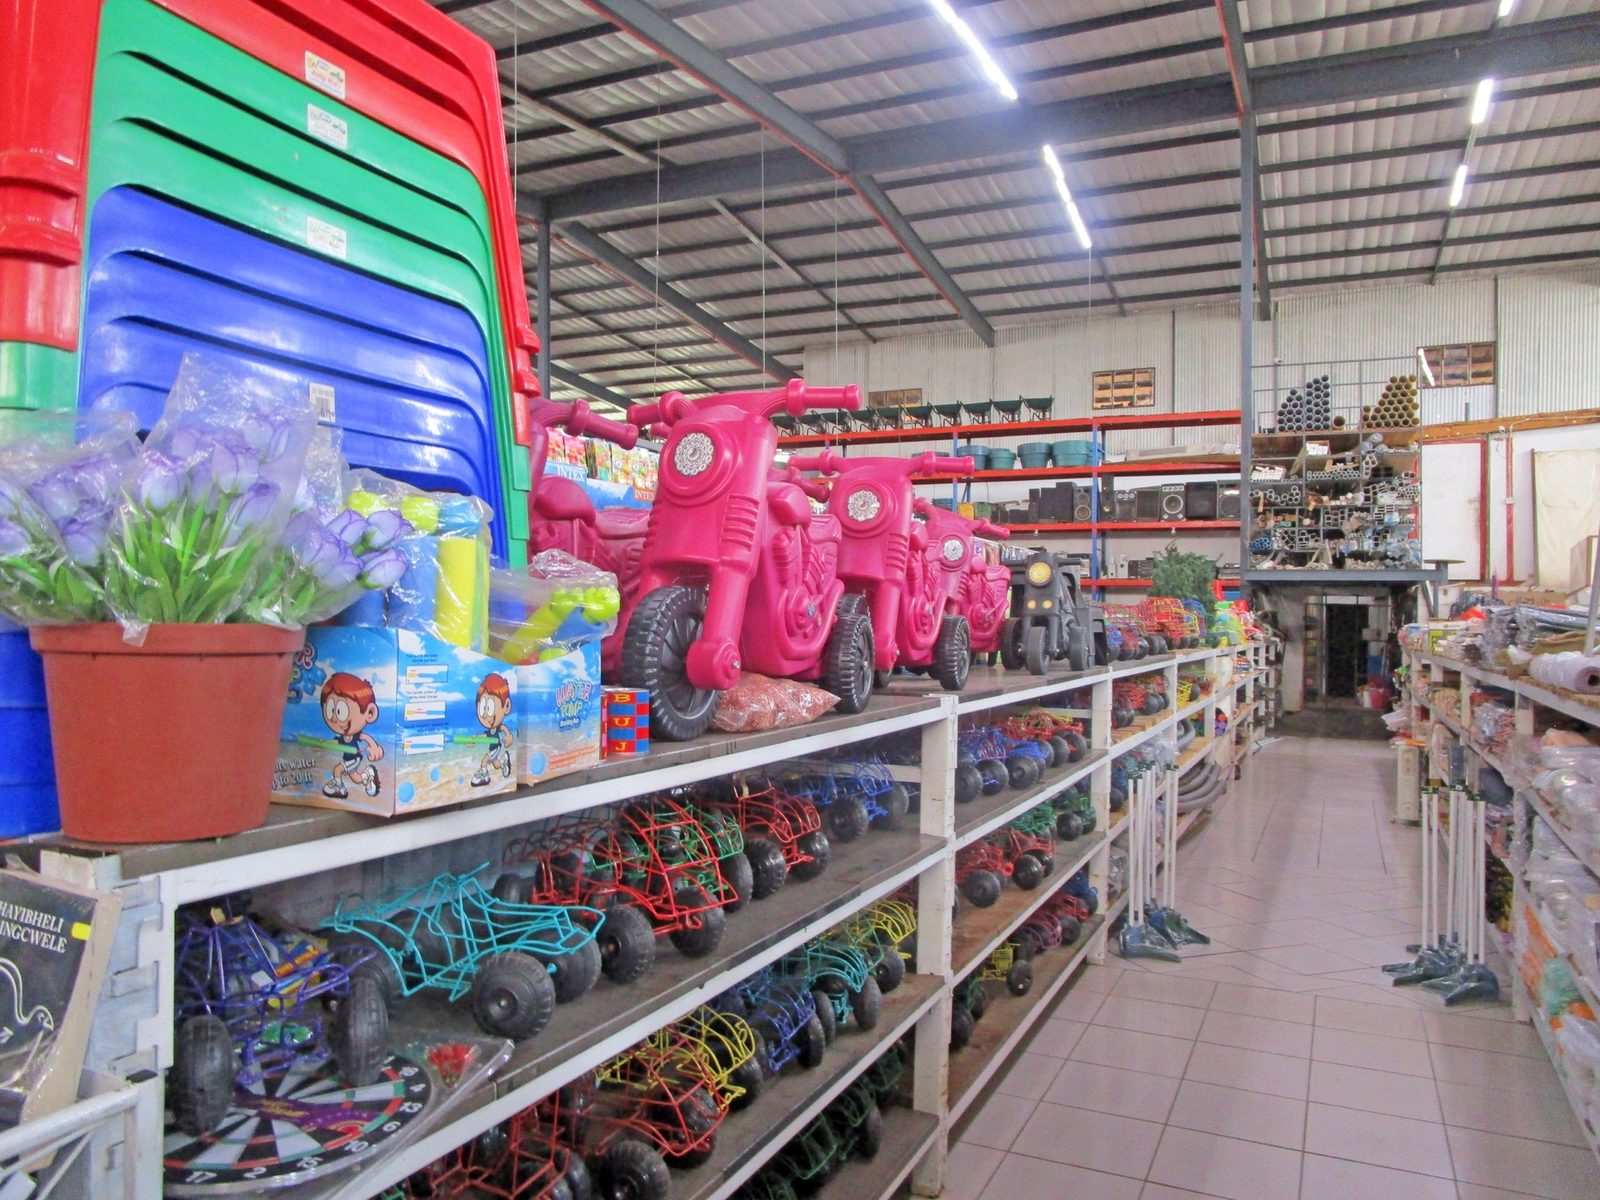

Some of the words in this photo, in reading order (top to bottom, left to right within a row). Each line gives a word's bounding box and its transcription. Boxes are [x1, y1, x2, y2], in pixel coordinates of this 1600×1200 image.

[556, 465, 585, 482] INTEX
[555, 679, 592, 707] WATER
[613, 693, 631, 703] B
[613, 717, 631, 727] U
[615, 741, 628, 751] J
[288, 758, 316, 770] water
[398, 1101, 423, 1113] 13
[382, 1121, 401, 1132] 6
[343, 1140, 369, 1152] 10
[185, 1170, 218, 1184] 17
[243, 1166, 268, 1179] 2
